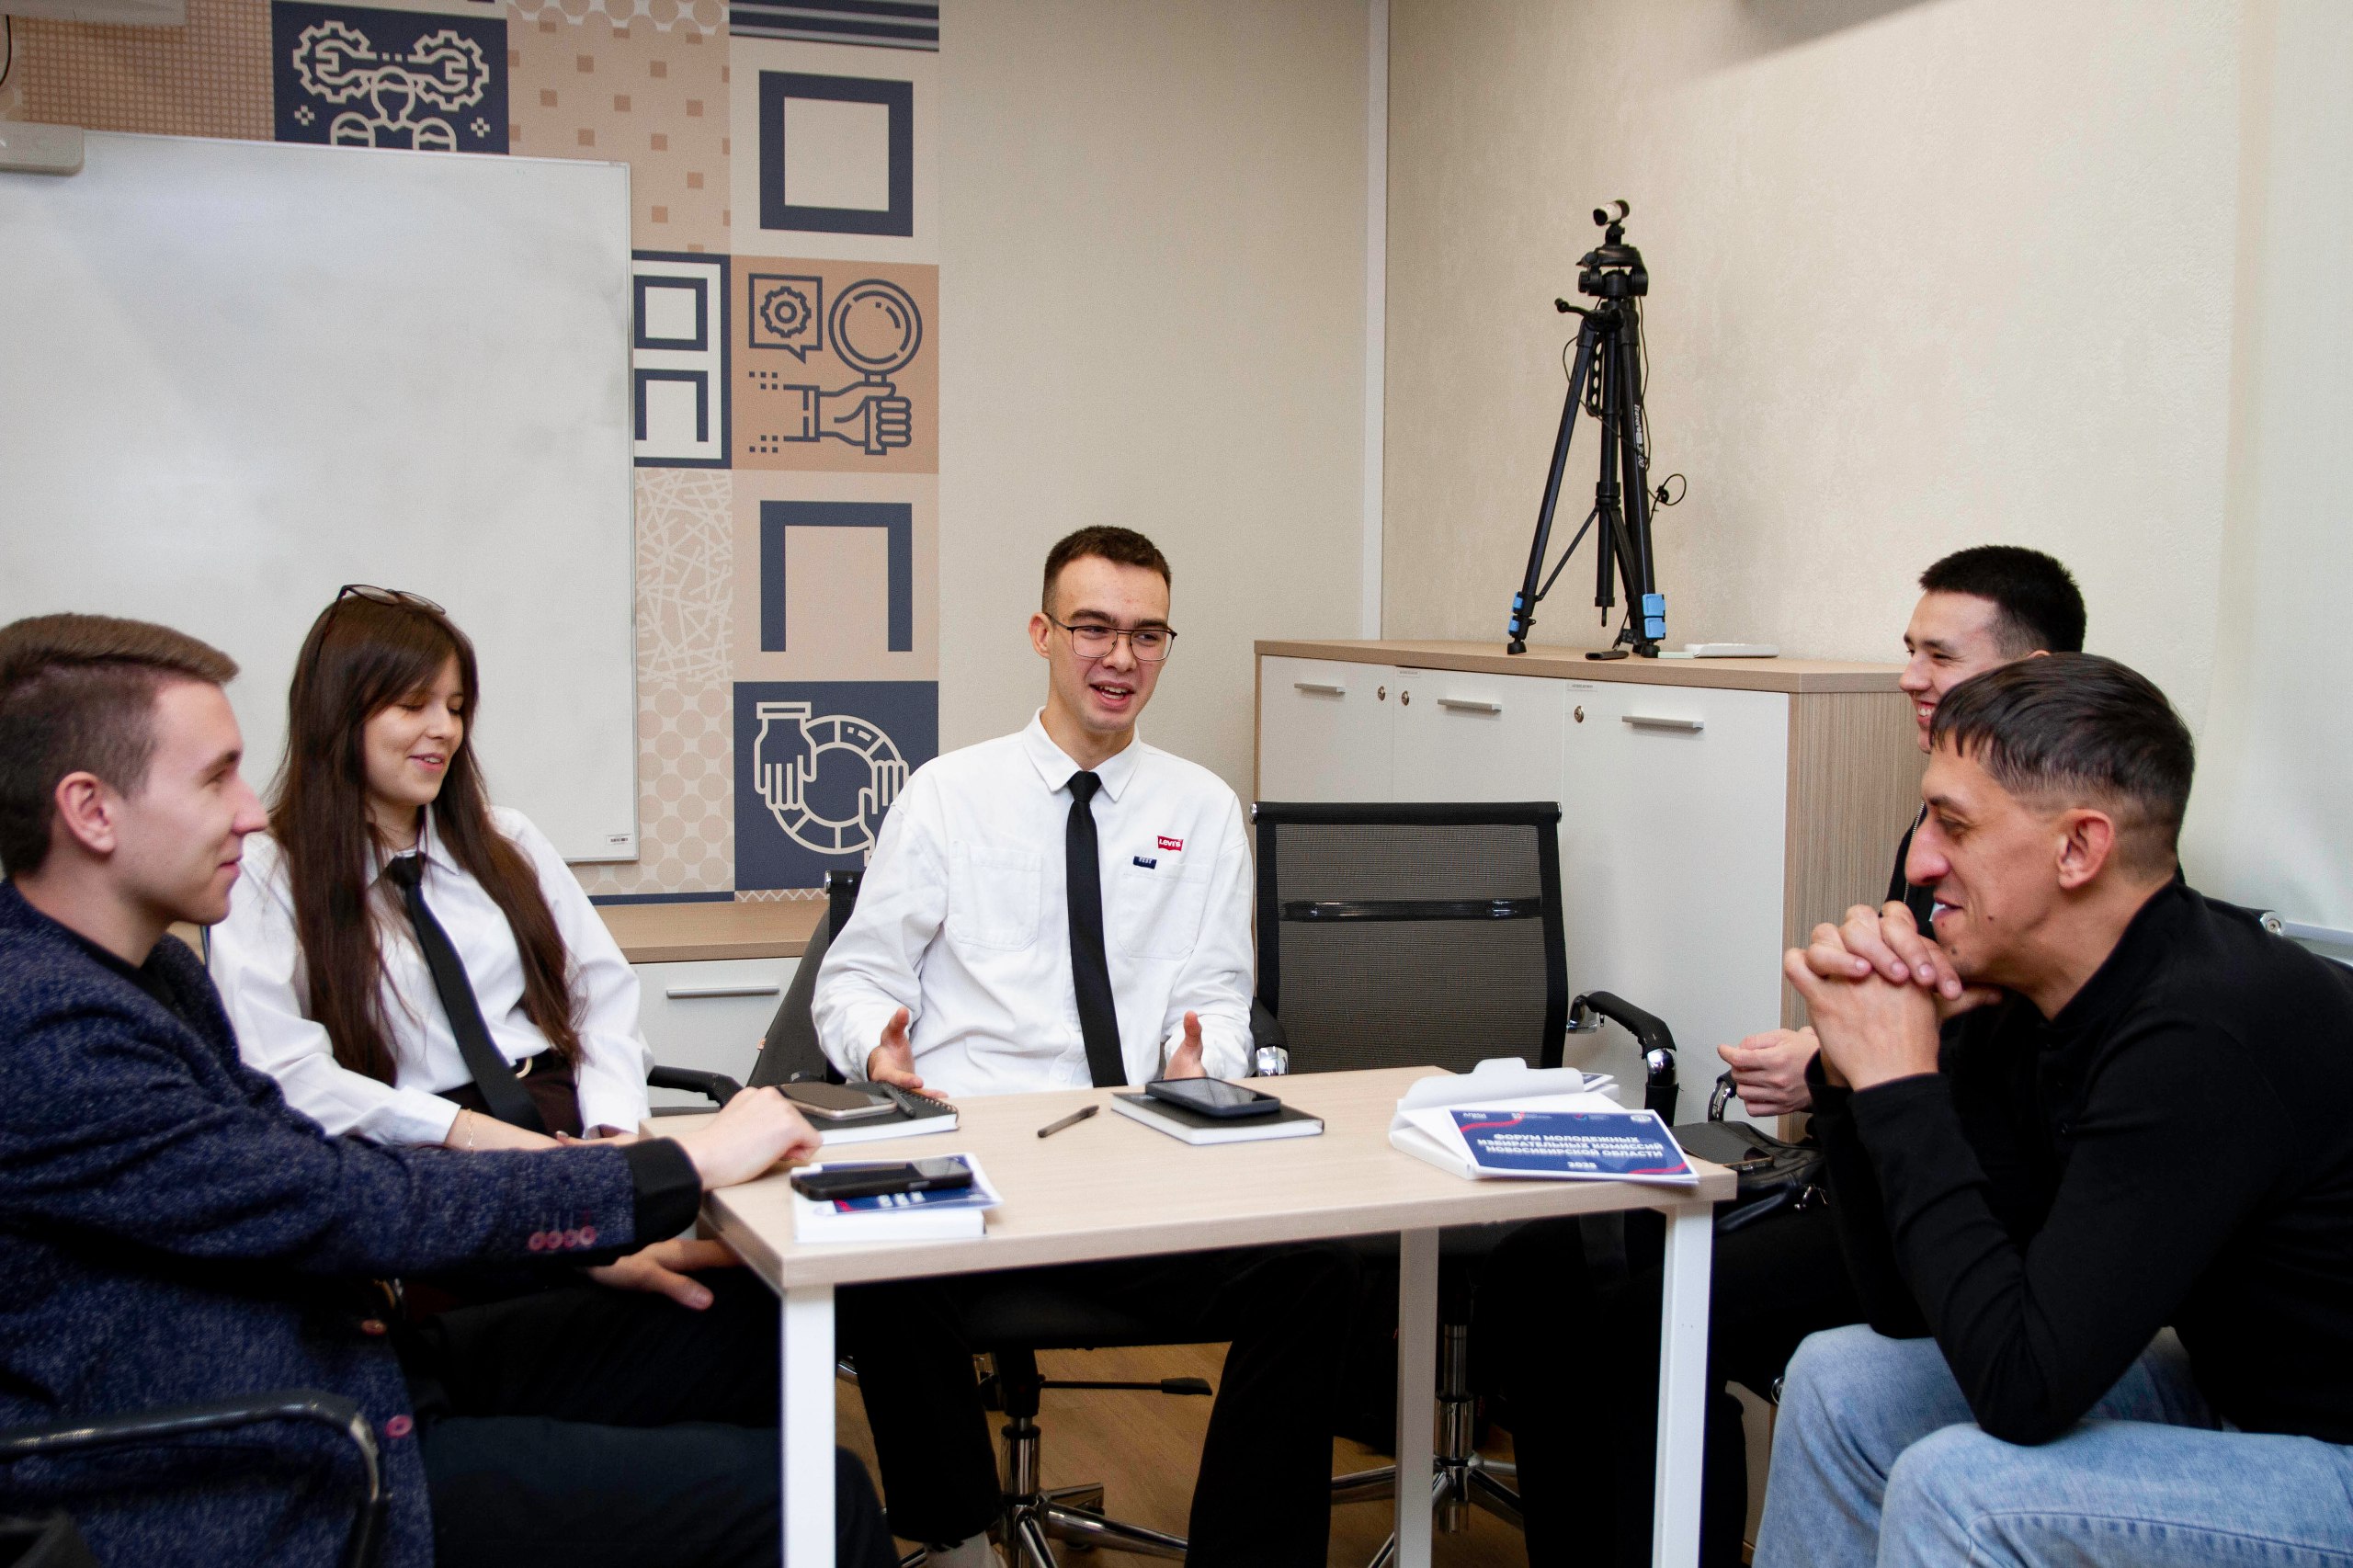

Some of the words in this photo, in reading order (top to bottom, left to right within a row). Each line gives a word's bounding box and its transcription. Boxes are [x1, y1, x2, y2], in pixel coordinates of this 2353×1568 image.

[1494, 1133, 1541, 1142] ФОРУМ
[1543, 1135, 1640, 1143] МОЛОДЕЖНЫХ
[1477, 1139, 1589, 1149] ИЗБИРАТЕЛЬНЫХ
[1592, 1142, 1664, 1151] КОМИССИЙ
[1485, 1146, 1600, 1156] НОВОСИБИРСКОЙ
[1602, 1150, 1664, 1158] ОБЛАСТИ
